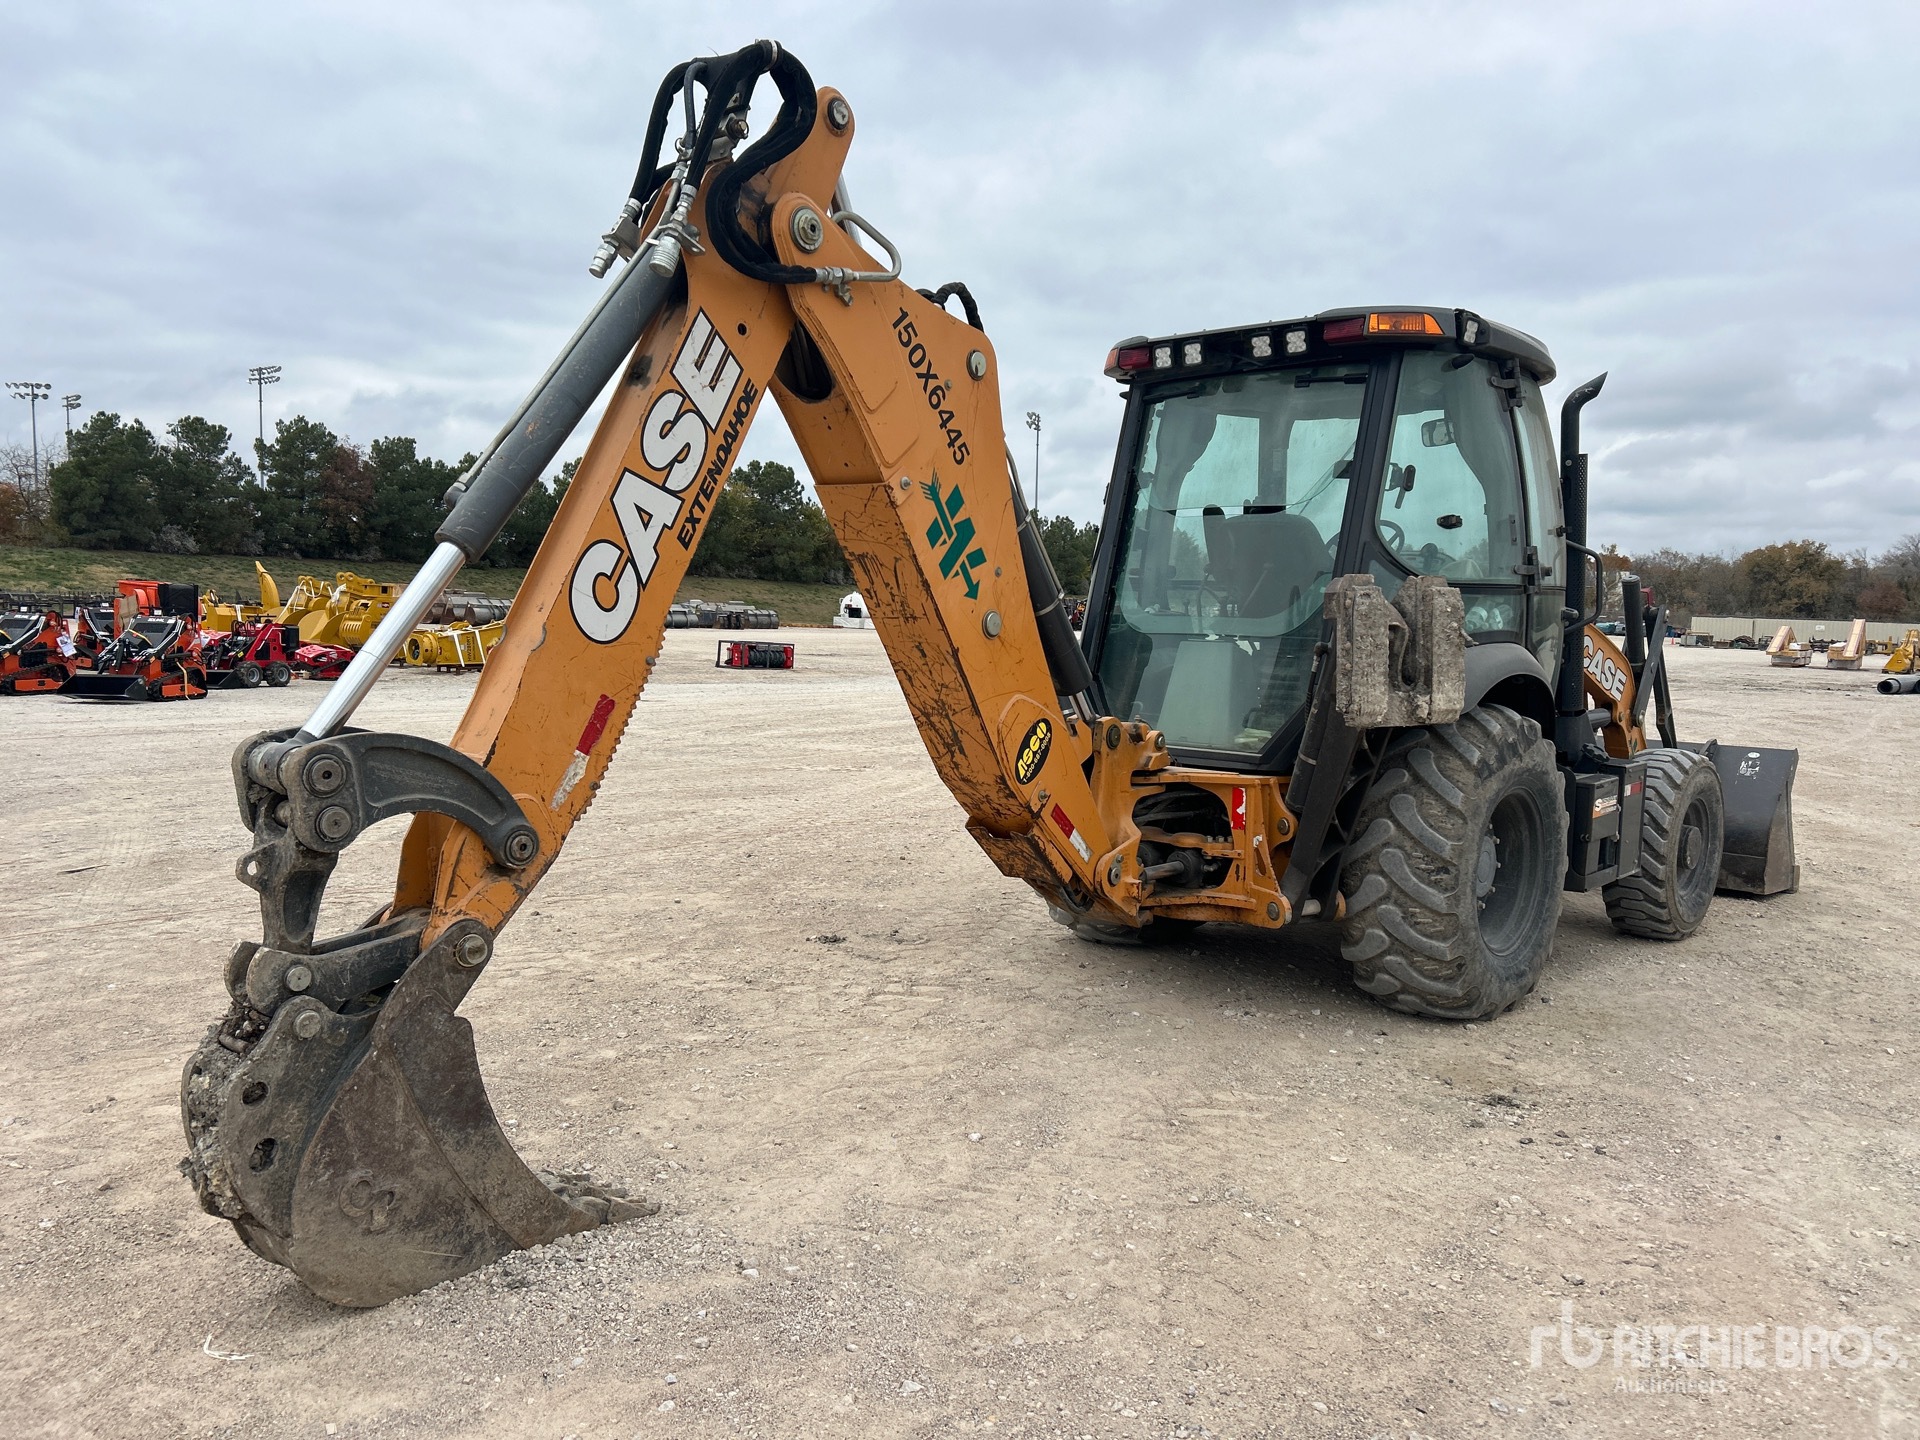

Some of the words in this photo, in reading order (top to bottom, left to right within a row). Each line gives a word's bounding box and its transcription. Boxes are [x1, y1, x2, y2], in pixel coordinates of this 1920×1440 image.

[676, 377, 760, 551] EXTENDAHOE
[892, 307, 971, 466] 150X6445
[569, 308, 744, 645] CASE
[1584, 635, 1628, 702] CASE
[1017, 721, 1047, 780] ASCO
